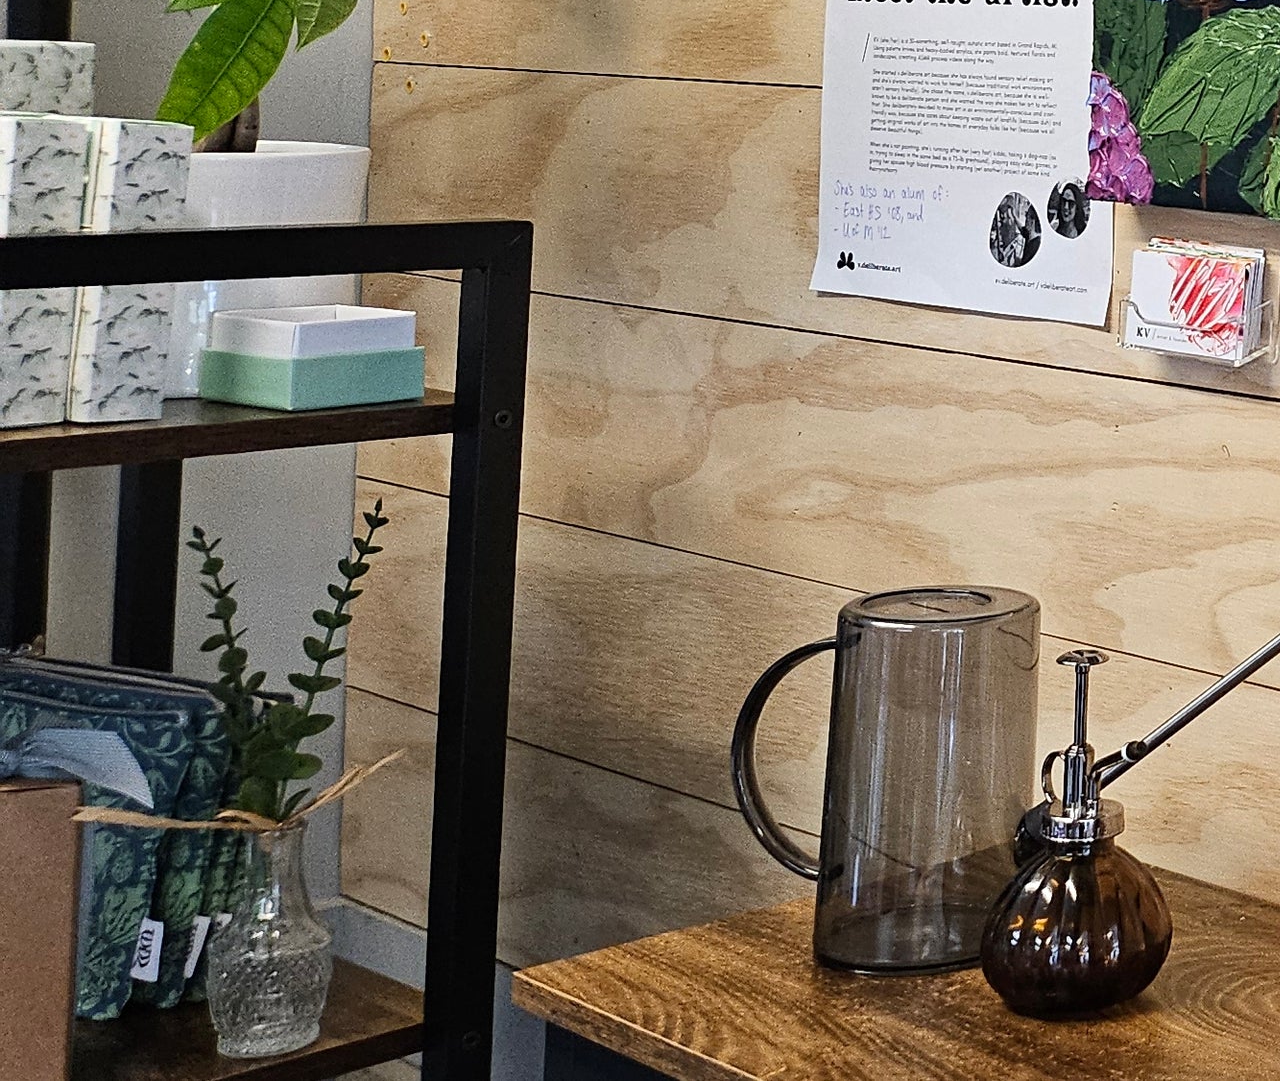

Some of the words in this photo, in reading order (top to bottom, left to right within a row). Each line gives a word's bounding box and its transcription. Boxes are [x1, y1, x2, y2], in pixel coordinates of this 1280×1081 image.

[860, 184, 877, 198] also
[884, 188, 895, 198] an
[902, 187, 924, 199] alum
[844, 202, 863, 218] East
[907, 204, 923, 222] and
[1136, 327, 1150, 338] KV
